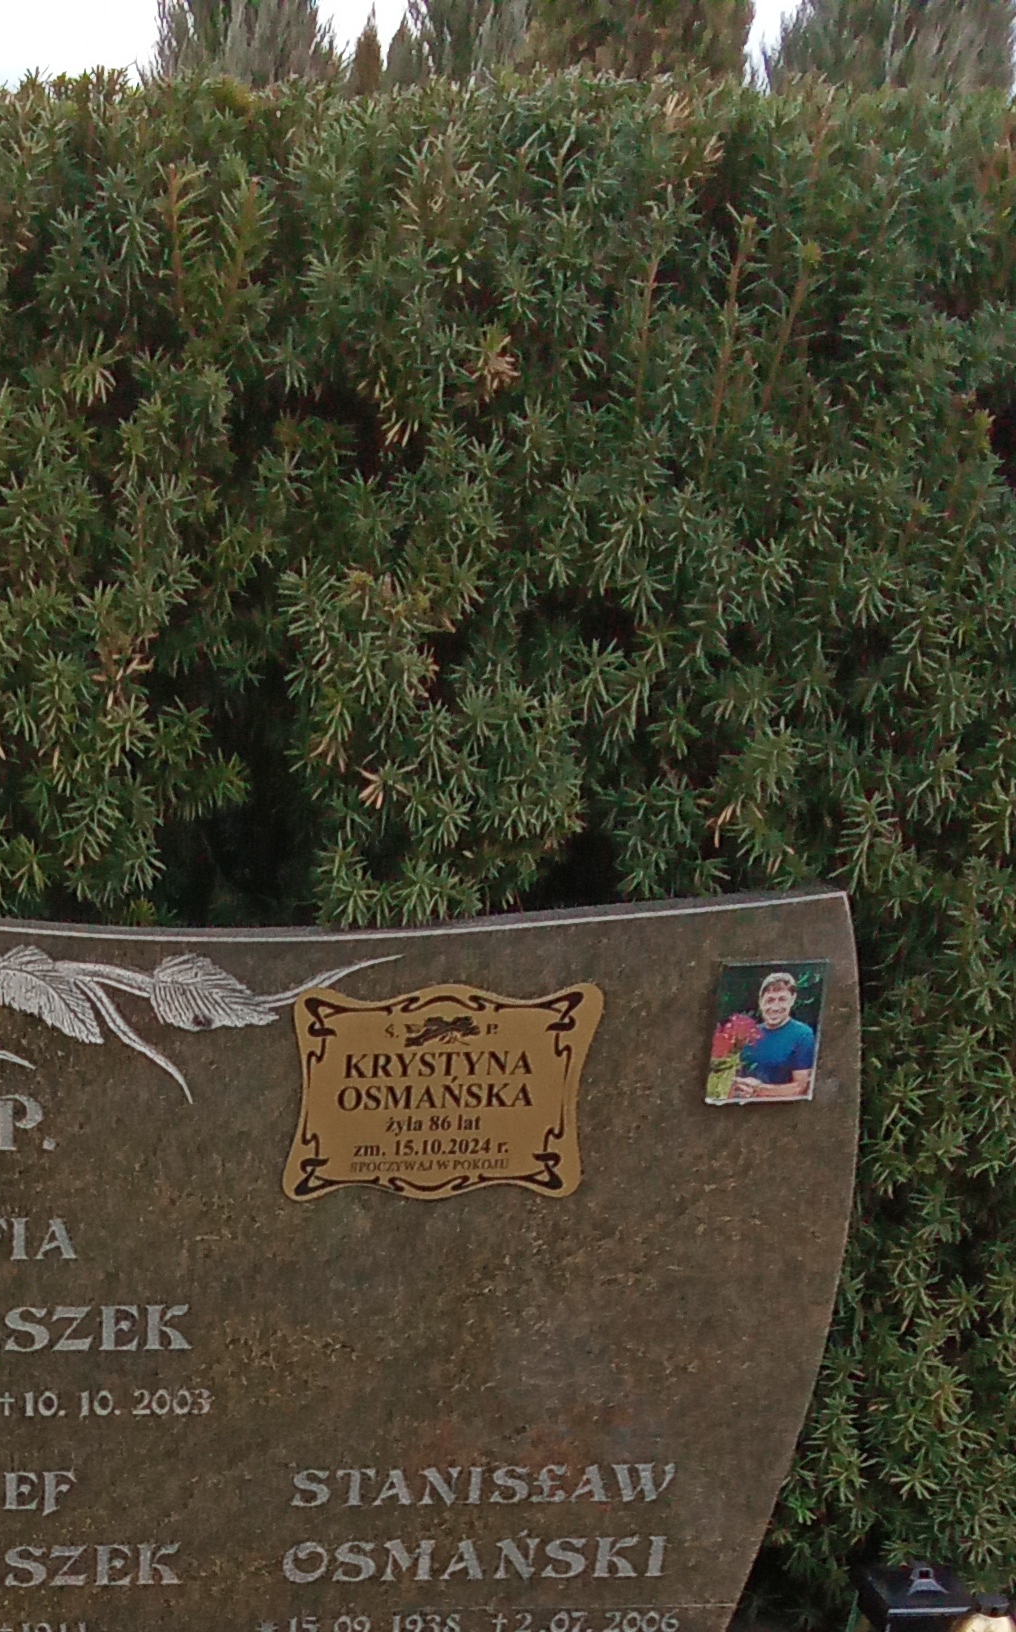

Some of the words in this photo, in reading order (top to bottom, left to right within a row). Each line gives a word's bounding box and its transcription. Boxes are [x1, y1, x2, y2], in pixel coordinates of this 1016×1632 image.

[343, 1051, 533, 1079] KRYSTYNA
[337, 1075, 534, 1111] OSMAŃSKA
[429, 1115, 452, 1132] 86
[456, 1113, 481, 1131] lat
[353, 1145, 386, 1157] zm.
[394, 1138, 491, 1156] 15.10.2024
[496, 1141, 509, 1154] r.
[350, 1158, 434, 1173] SPOCZYWAJ
[435, 1158, 451, 1171] W
[452, 1157, 509, 1171] POKOJU
[290, 1462, 677, 1508] STANISŁAW
[282, 1529, 668, 1584] OSMAŃSKI
